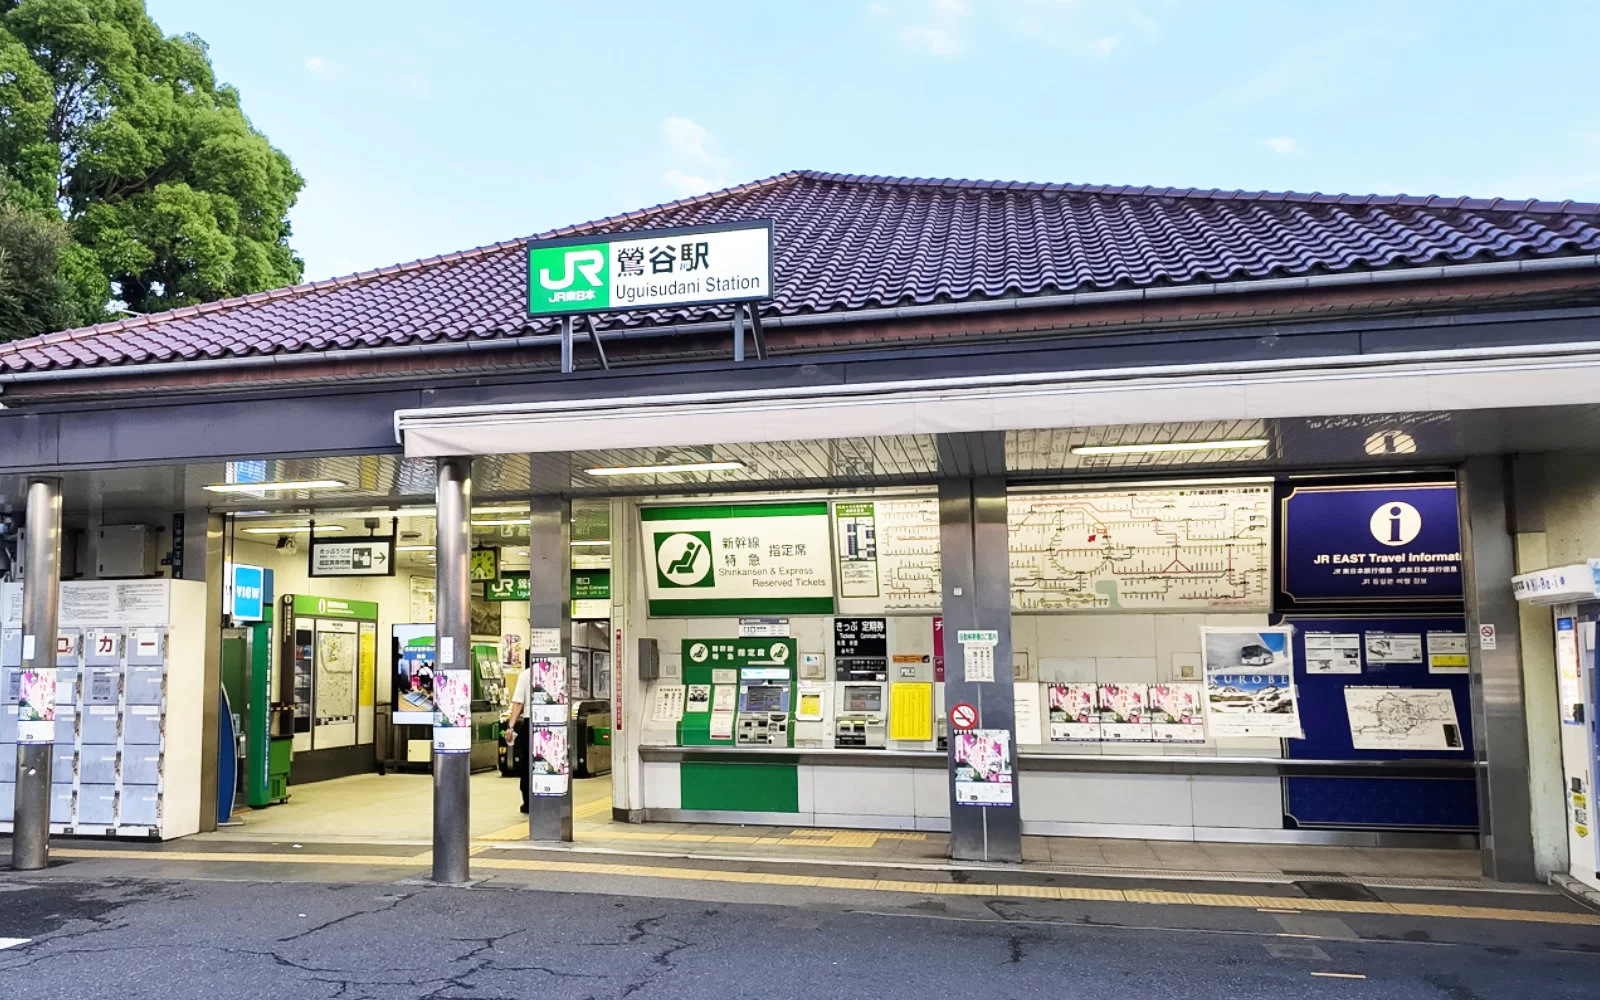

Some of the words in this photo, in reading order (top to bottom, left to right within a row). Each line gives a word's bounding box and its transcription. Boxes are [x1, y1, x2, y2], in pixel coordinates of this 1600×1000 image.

[617, 242, 710, 278] 鶯谷駅
[540, 250, 604, 290] JR
[616, 279, 701, 302] Uguisudani
[706, 274, 760, 293] Station
[548, 290, 596, 304] JR東日本
[722, 536, 760, 550] 新幹線
[768, 544, 807, 557] 指定席
[1314, 555, 1330, 564] JR
[1333, 554, 1366, 564] EAST
[1368, 553, 1406, 562] Travel
[718, 567, 768, 576] Shinkansen
[770, 567, 776, 576] &
[779, 566, 814, 576] Express
[752, 578, 792, 588] Reserved
[796, 578, 826, 587] Tickets
[836, 621, 858, 632] きっぷ
[1208, 674, 1289, 686] KUROBE
